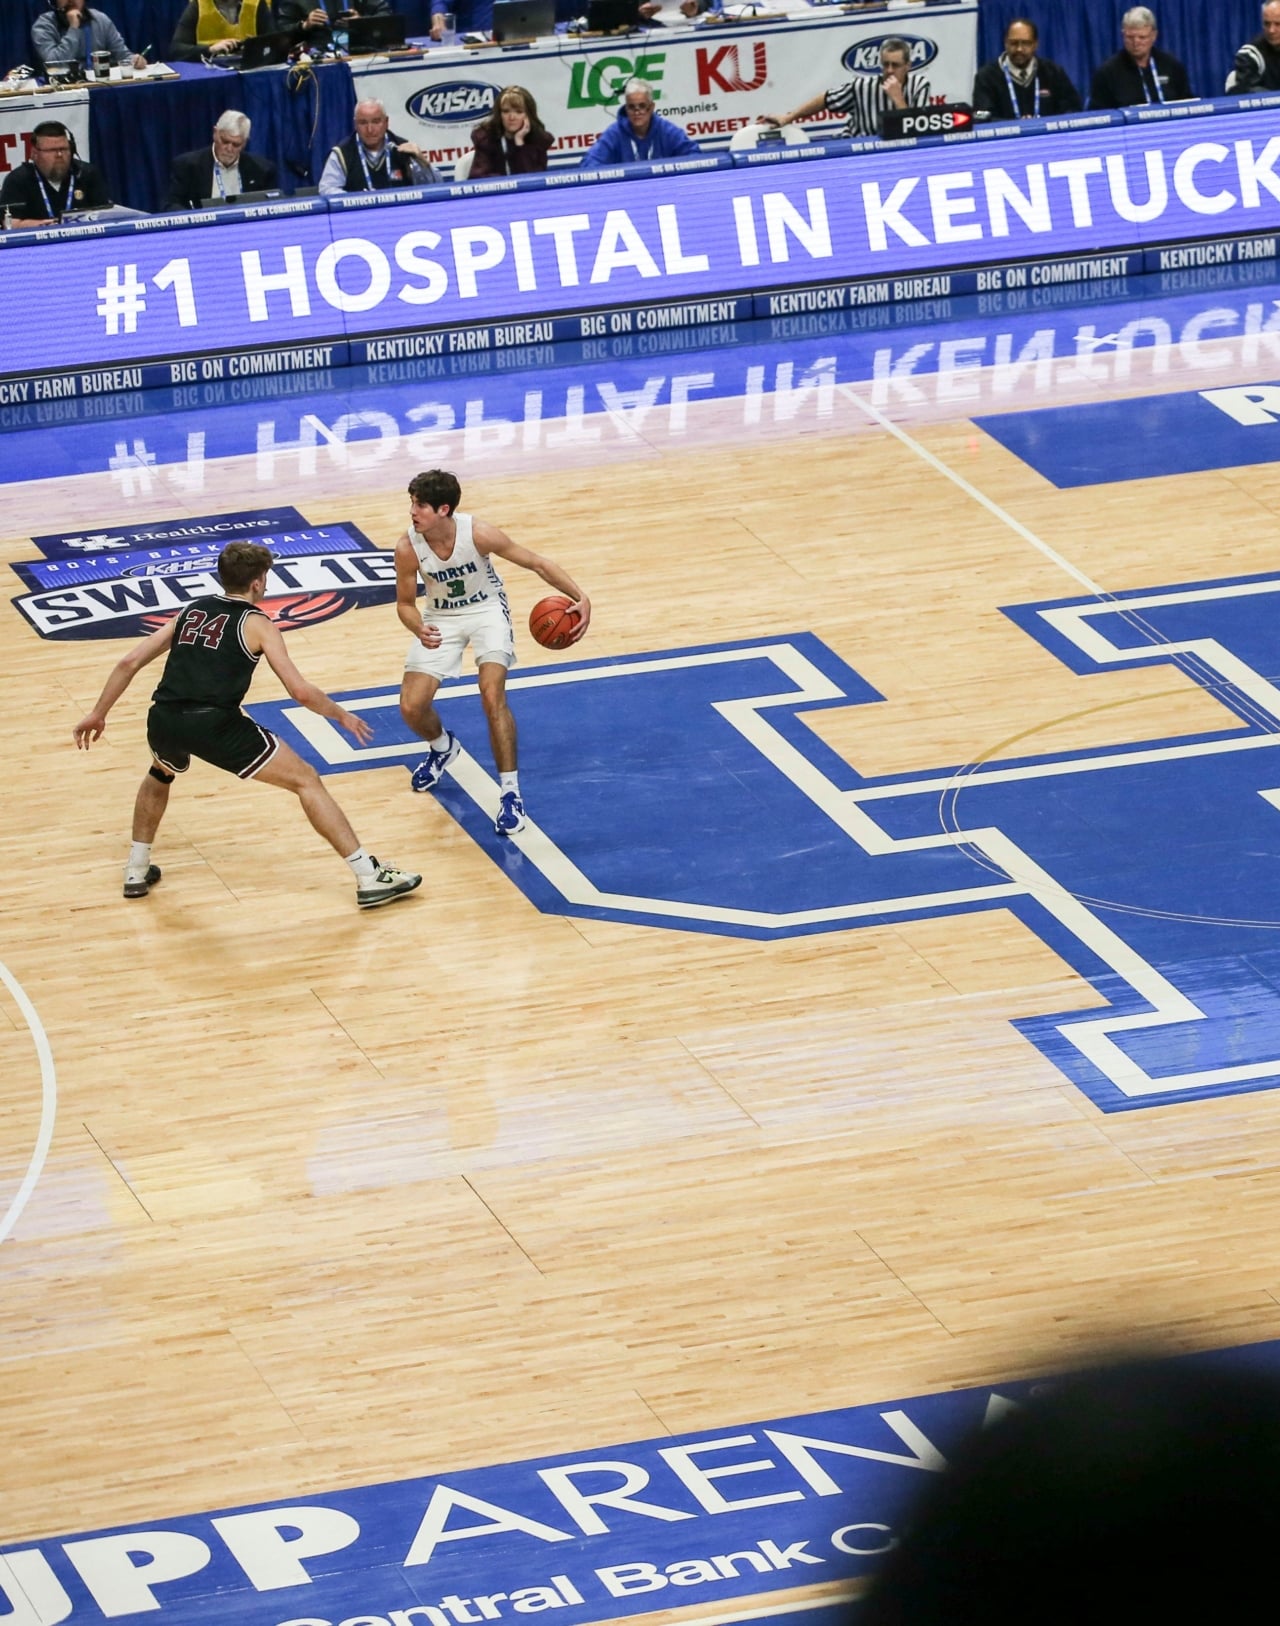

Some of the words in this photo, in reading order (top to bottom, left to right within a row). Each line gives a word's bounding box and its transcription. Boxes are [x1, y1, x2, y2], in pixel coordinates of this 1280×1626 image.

[695, 42, 767, 95] KU
[420, 87, 494, 116] KHSAA
[655, 101, 718, 117] companies
[903, 113, 954, 134] POSS
[96, 257, 198, 336] #1
[241, 204, 710, 321] HOSPITAL
[733, 187, 834, 267] IN
[1160, 242, 1234, 270] KENTUCKY
[1238, 238, 1276, 260] FARM
[977, 272, 1001, 292] BIG
[1006, 268, 1027, 288] ON
[1031, 256, 1129, 284] COMMITMENT
[770, 288, 845, 315] KENTUCKY
[850, 283, 889, 305] FARM
[894, 276, 951, 300] BUREAU
[580, 316, 607, 336] BIG
[611, 313, 632, 332] ON
[637, 301, 737, 329] COMMITMENT
[366, 335, 444, 361] KENTUCKY
[449, 330, 490, 352] FARM
[495, 322, 553, 346] BUREAU
[170, 361, 197, 383] BIG
[202, 358, 224, 379] ON
[229, 347, 333, 377] COMMITMENT
[35, 378, 76, 399] FARM
[82, 369, 143, 395] BUREAU
[62, 534, 130, 552] UK
[149, 531, 330, 558] BASKBALL
[427, 561, 478, 583] NORTH
[446, 580, 466, 599] 3
[32, 562, 303, 625] SWET
[178, 609, 230, 650] 24
[594, 1539, 827, 1599] Bank
